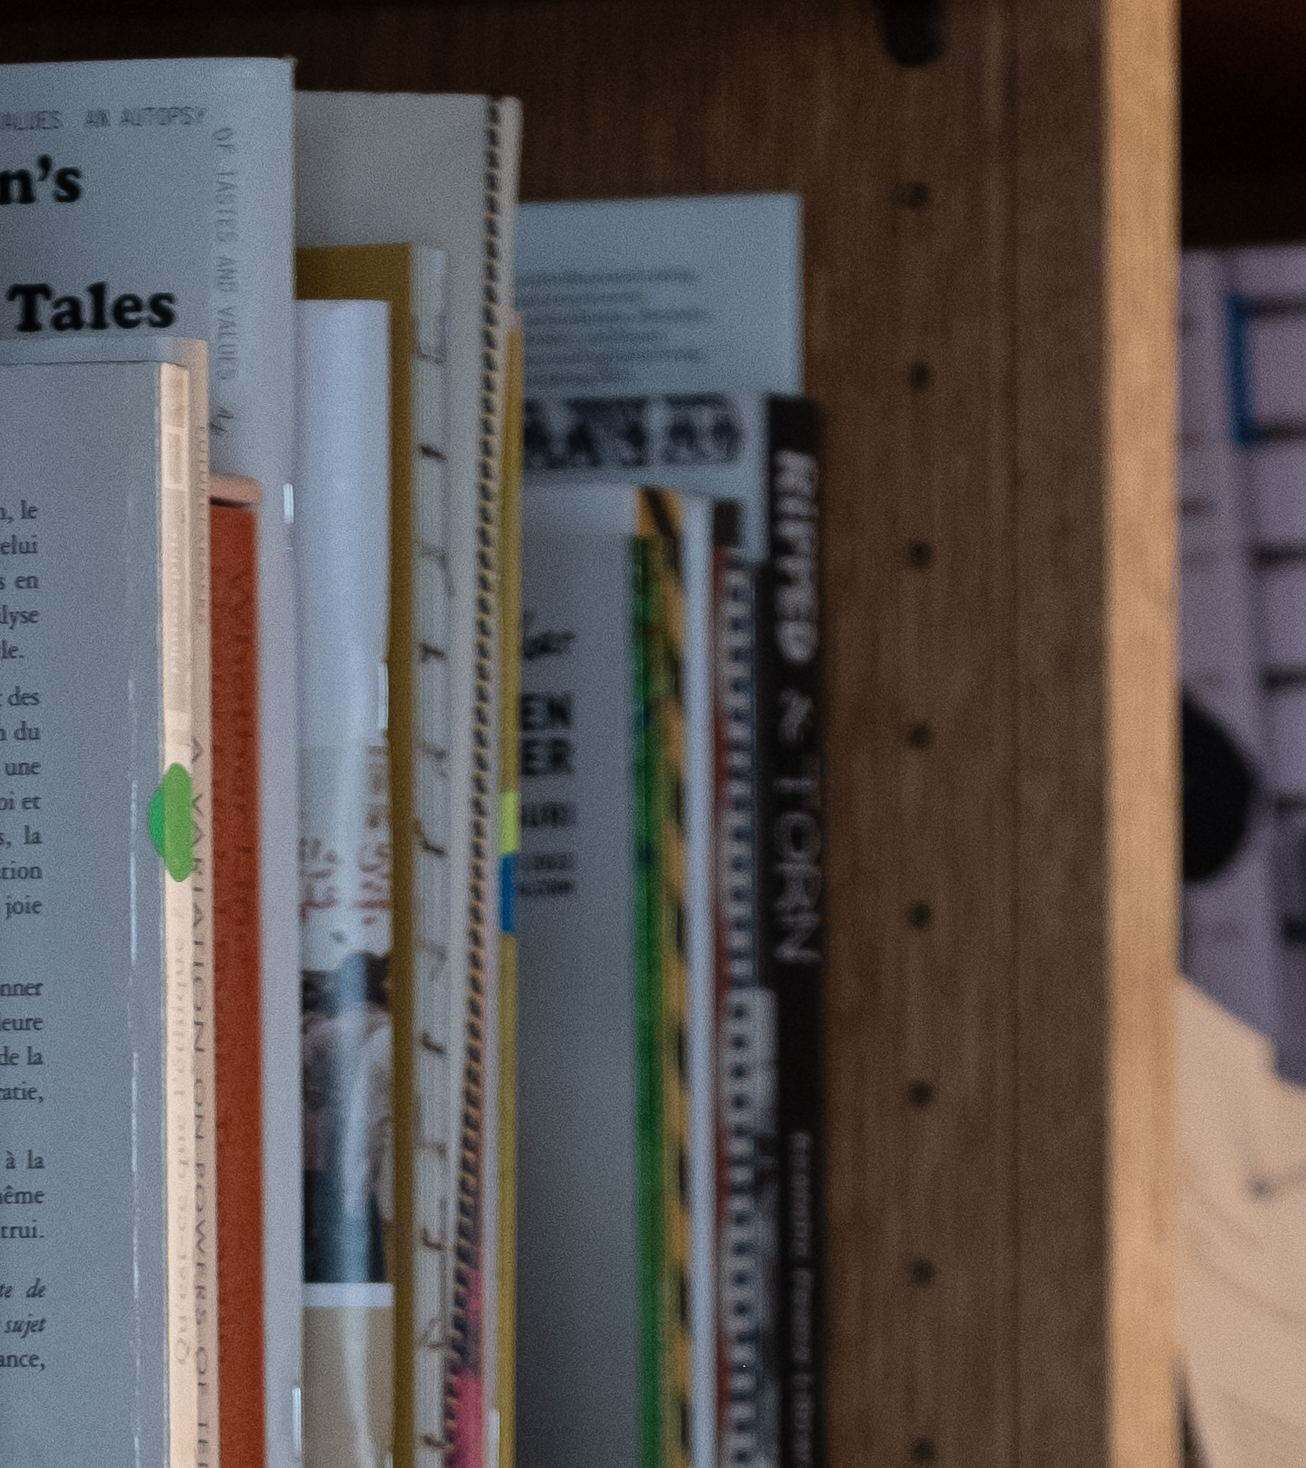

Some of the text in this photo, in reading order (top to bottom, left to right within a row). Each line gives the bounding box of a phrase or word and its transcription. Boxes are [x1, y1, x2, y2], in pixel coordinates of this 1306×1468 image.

[8, 282, 177, 333] Tales
[21, 499, 39, 520] le
[15, 574, 40, 590] en
[8, 684, 40, 707] des
[14, 718, 41, 742] du
[5, 760, 41, 776] une
[21, 795, 41, 811] et
[24, 824, 42, 846] la
[6, 895, 42, 919] joie
[27, 1045, 43, 1066] la
[5, 1149, 44, 1170] à la
[26, 1277, 46, 1299] de
[4, 1312, 47, 1338] sujet
